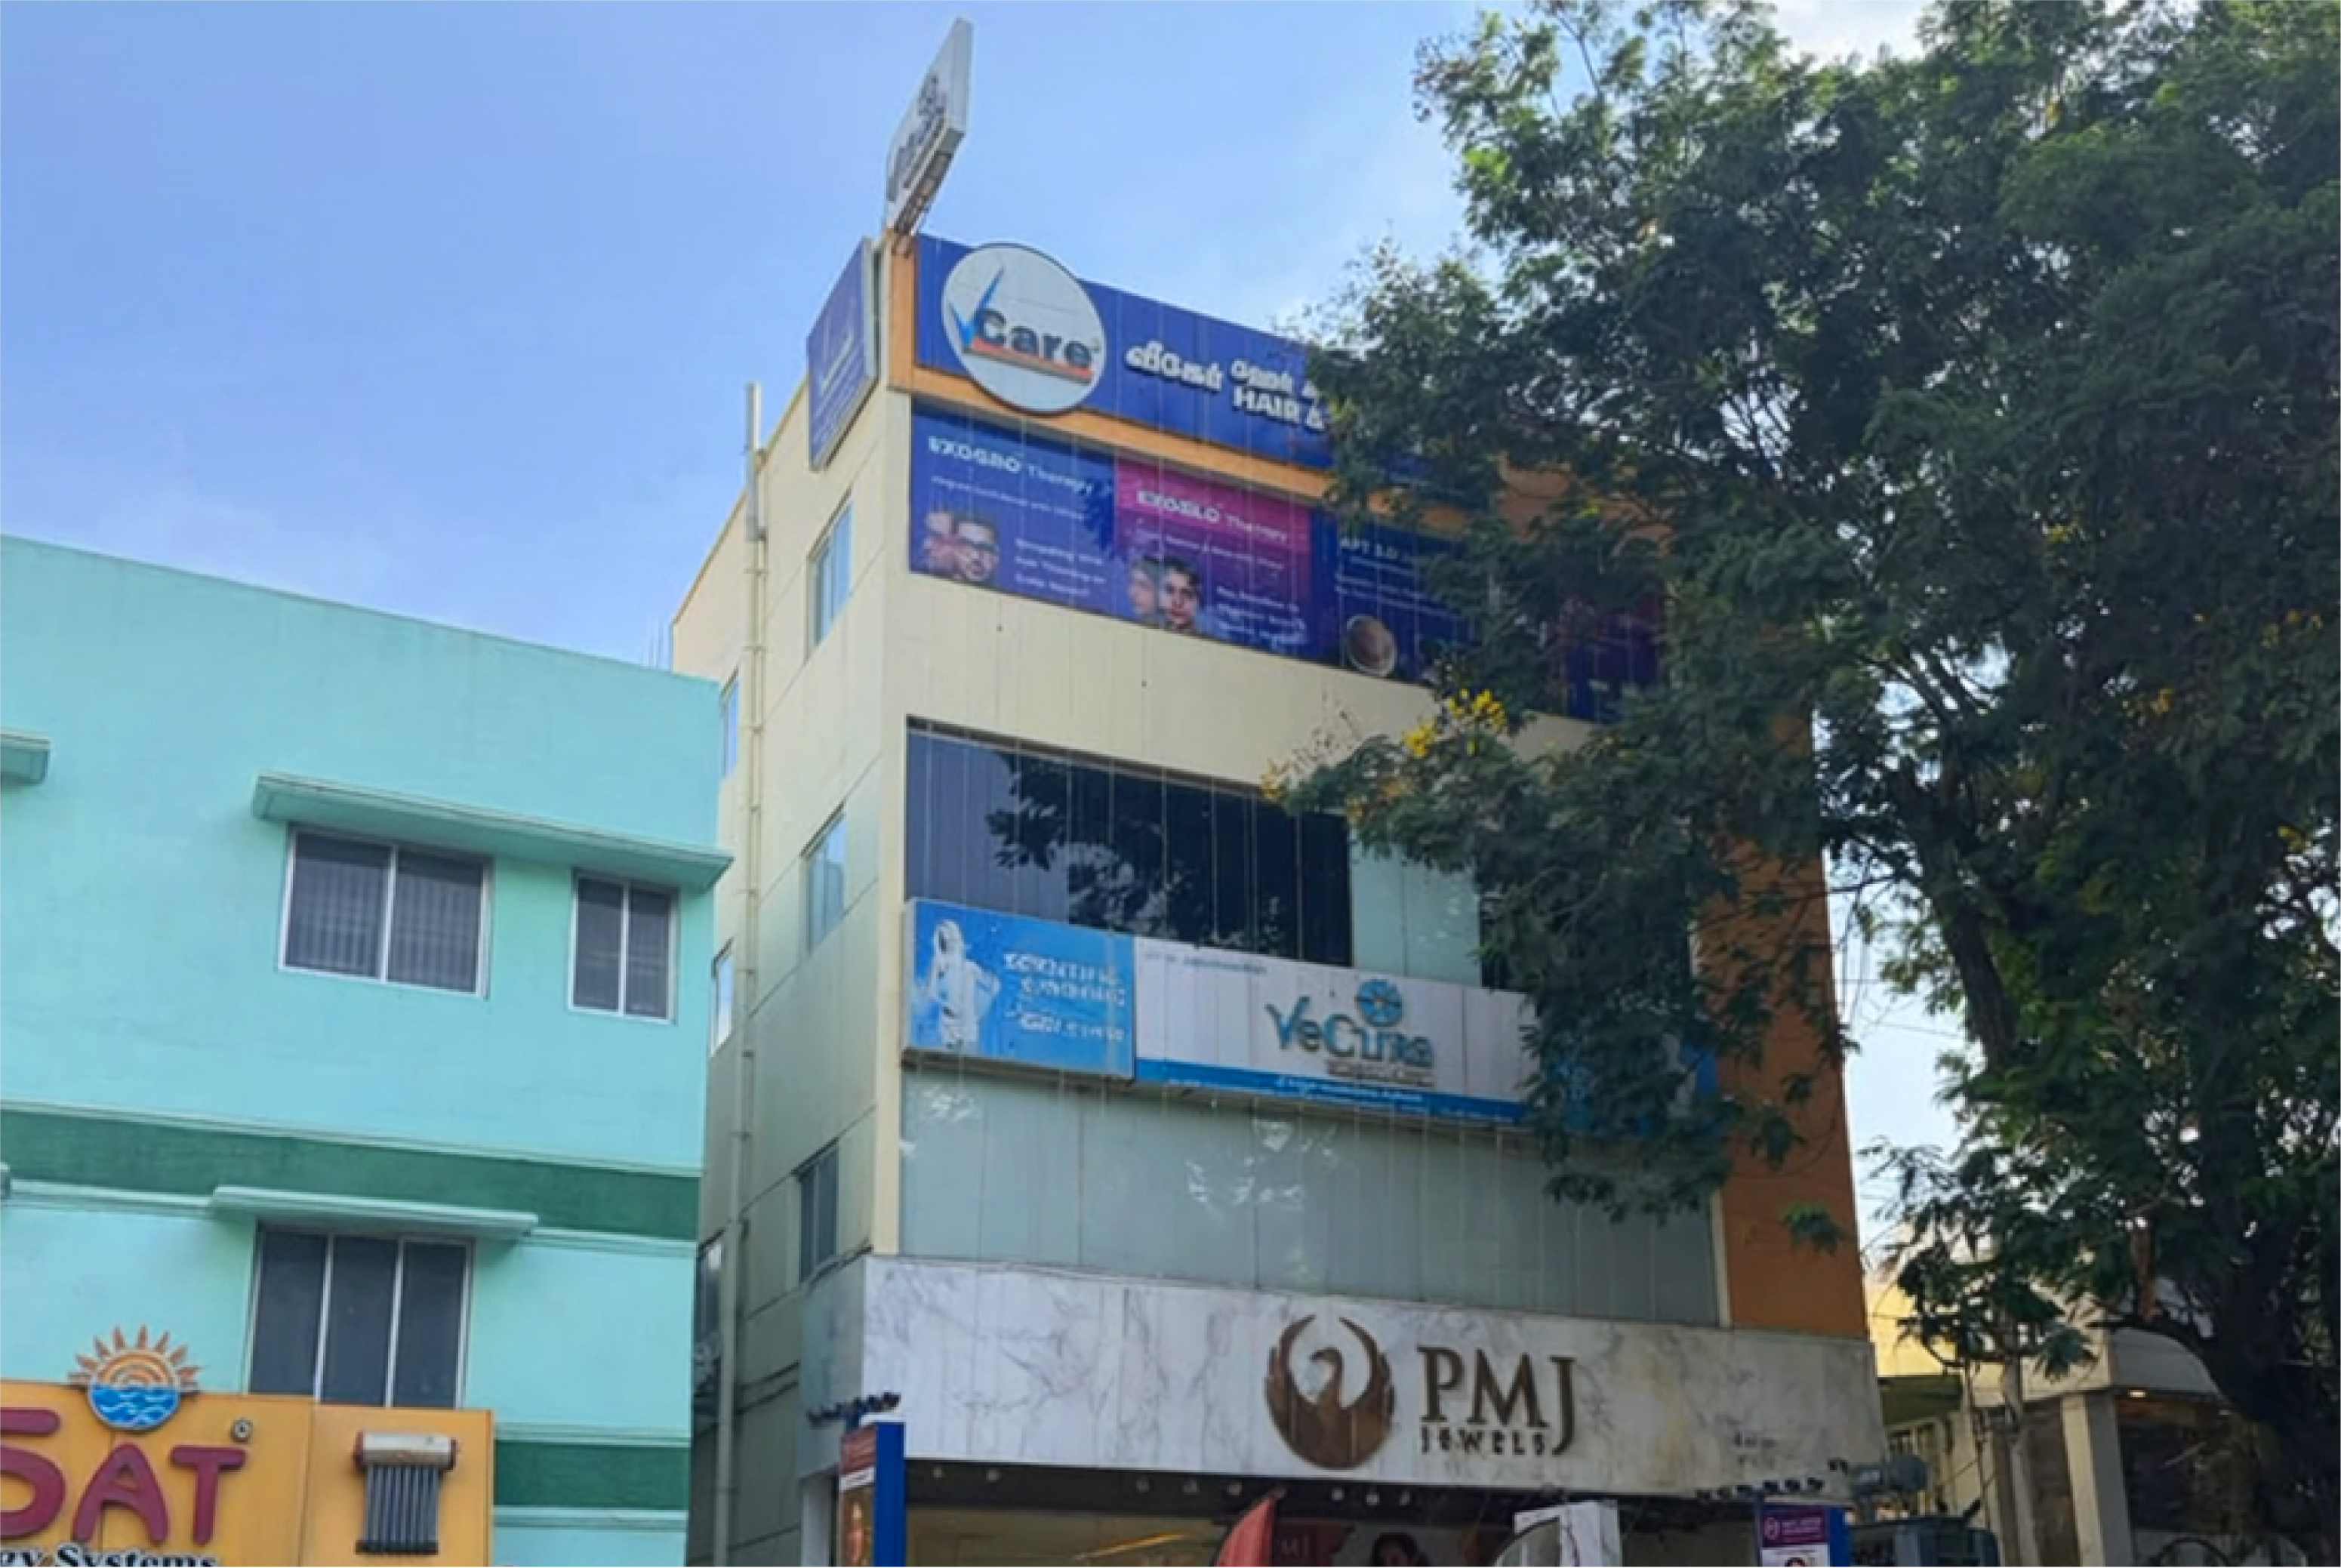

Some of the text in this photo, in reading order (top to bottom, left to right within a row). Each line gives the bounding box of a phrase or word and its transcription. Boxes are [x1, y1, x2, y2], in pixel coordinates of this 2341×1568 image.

[1233, 385, 1324, 430] HAIR &
[1417, 1344, 1576, 1457] PMJ
[1421, 1426, 1546, 1456] JEWELS
